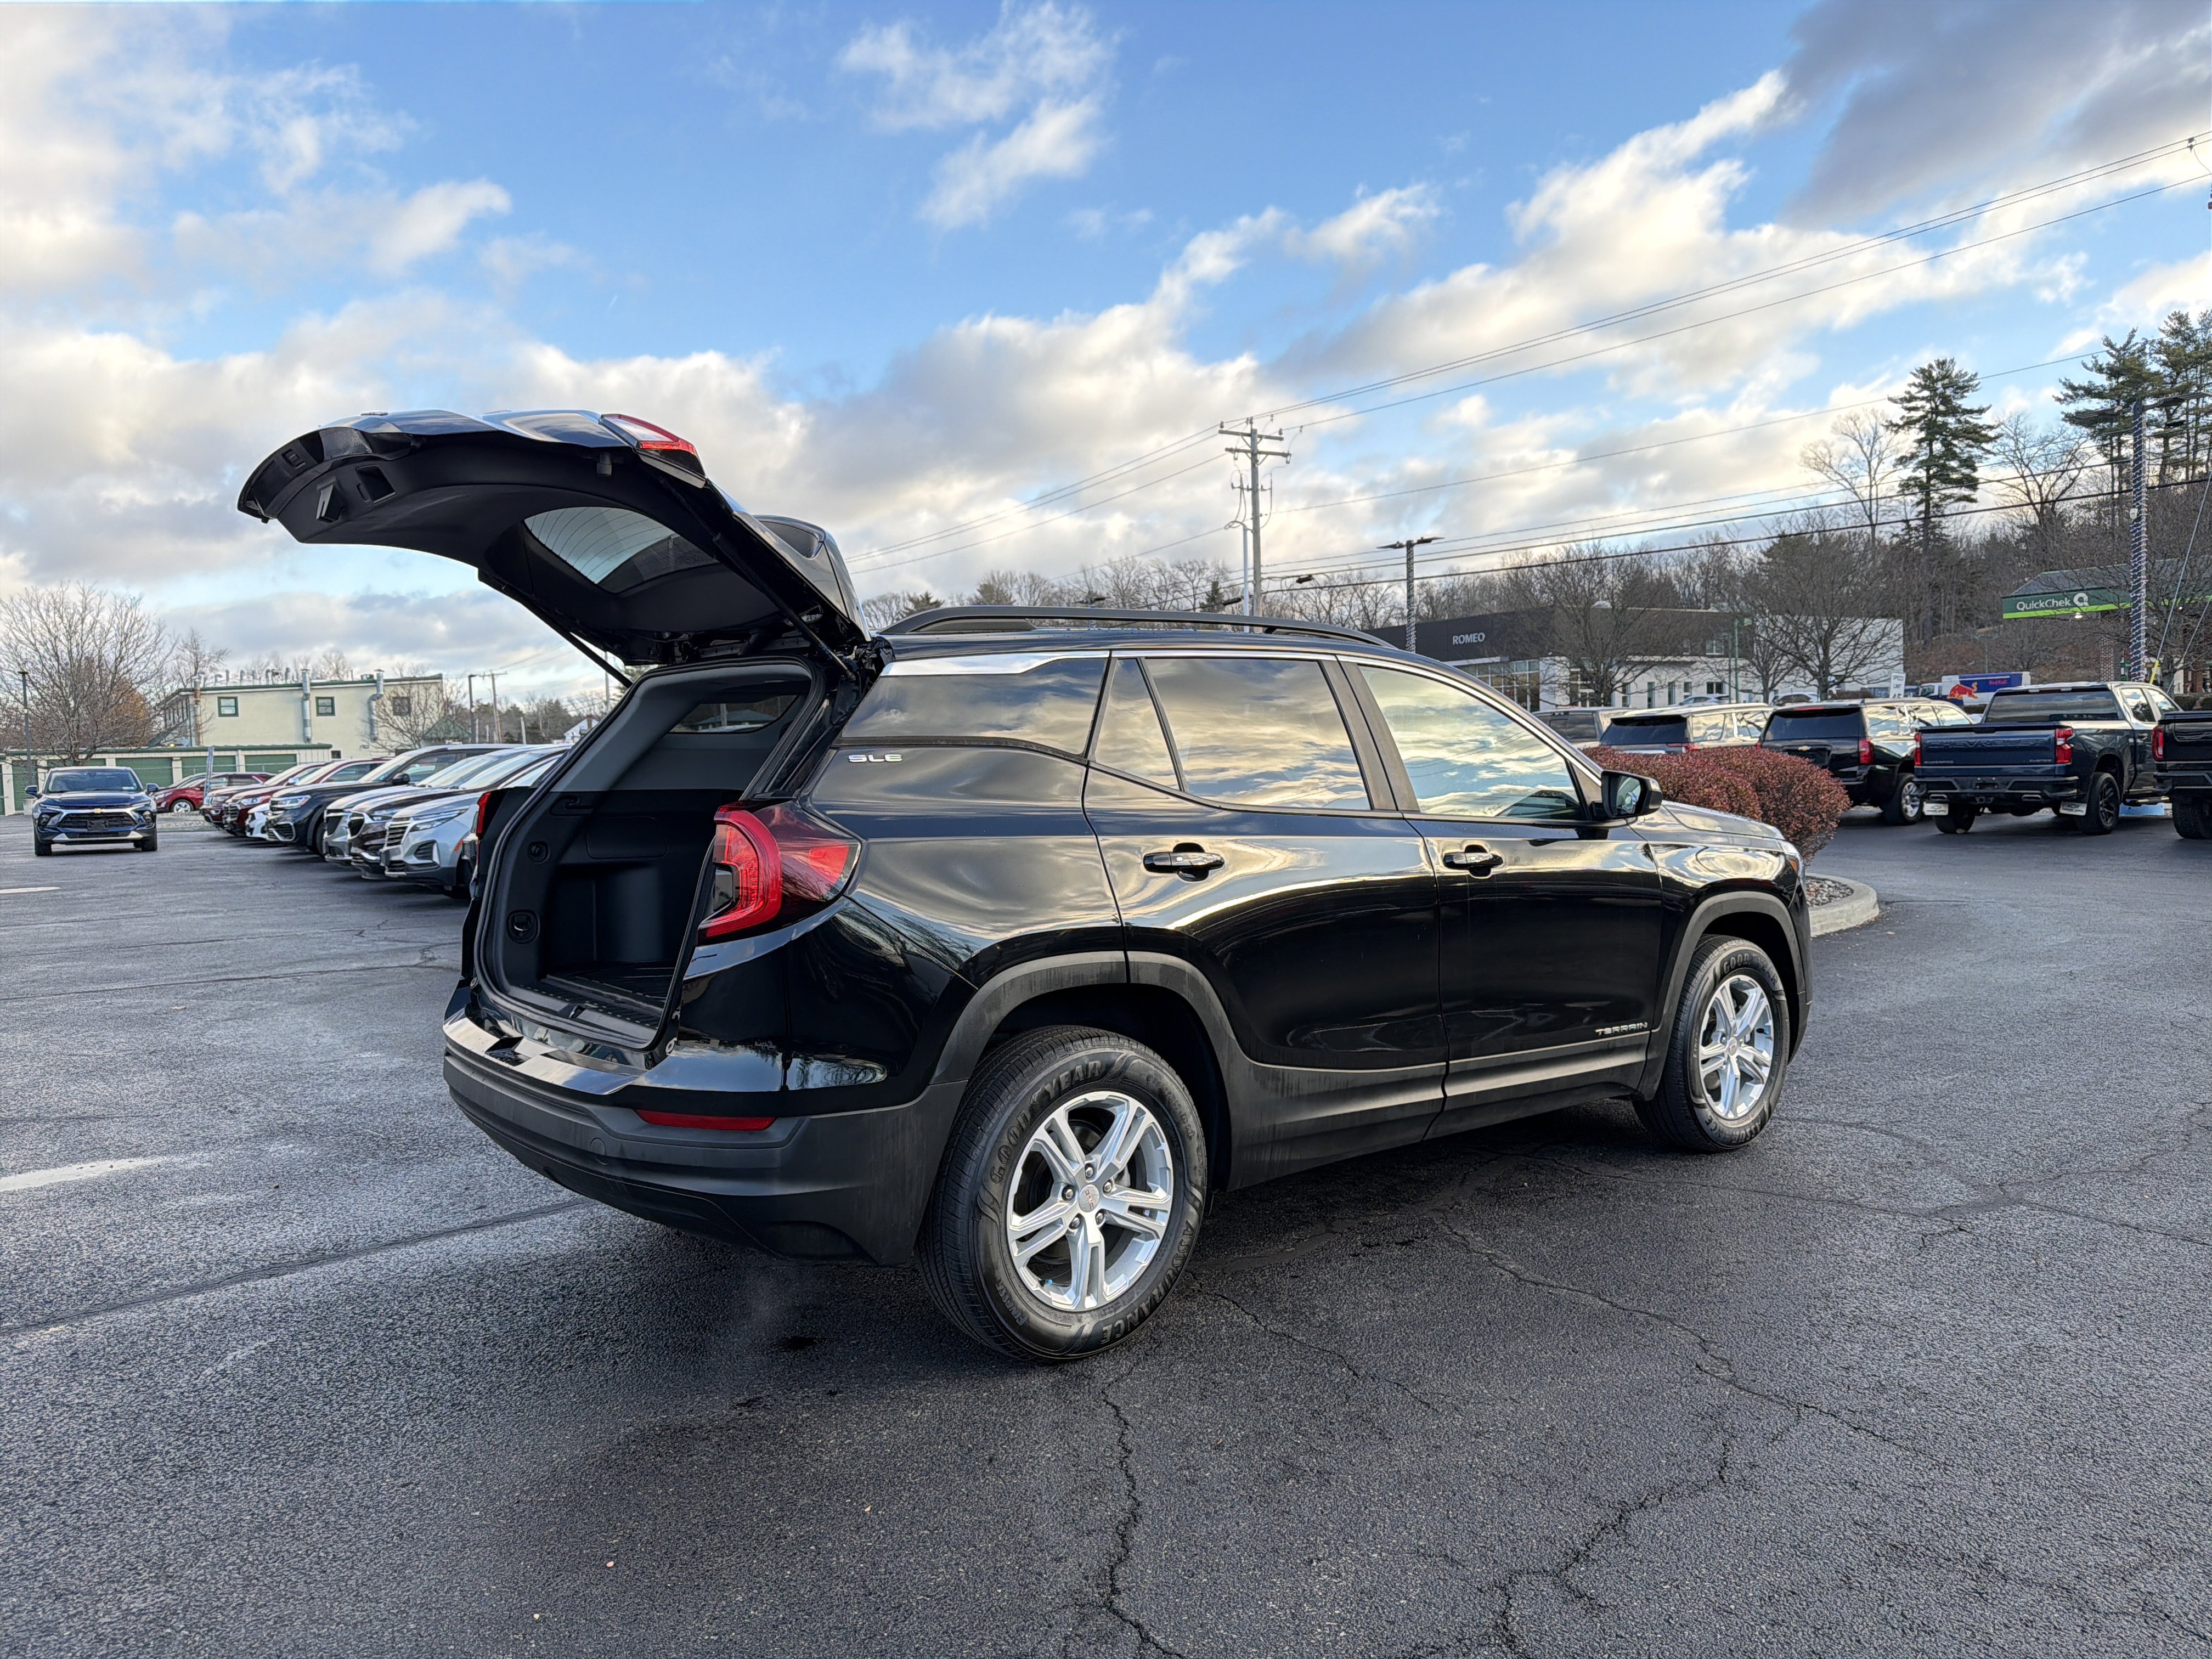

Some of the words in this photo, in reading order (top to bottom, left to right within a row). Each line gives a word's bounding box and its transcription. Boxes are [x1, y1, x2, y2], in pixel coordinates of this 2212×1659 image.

[2016, 597, 2072, 611] QuickChek
[1452, 632, 1486, 645] ROMEO
[848, 754, 903, 763] SLE
[1595, 1022, 1648, 1036] TERRAIN
[1100, 1220, 1195, 1345] ASSURANCE
